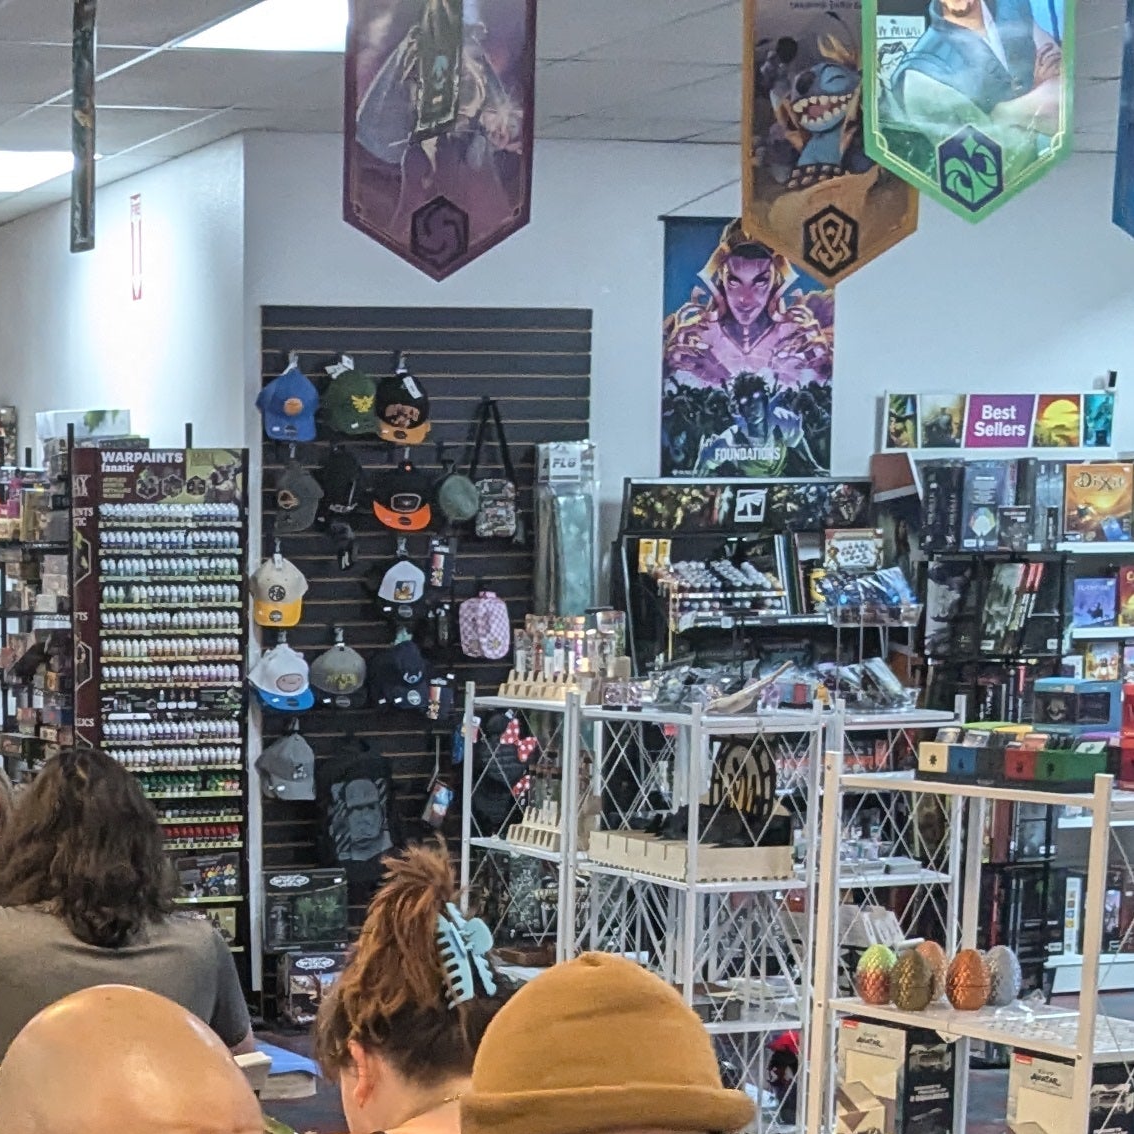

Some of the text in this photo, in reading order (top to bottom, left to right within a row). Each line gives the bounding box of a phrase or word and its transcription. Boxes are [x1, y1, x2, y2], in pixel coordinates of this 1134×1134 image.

[982, 404, 1016, 420] Best
[974, 421, 1026, 437] Sellers
[101, 451, 184, 463] WARPAINTS
[714, 447, 781, 461] FOUNDATIONS
[101, 462, 134, 473] fanatic
